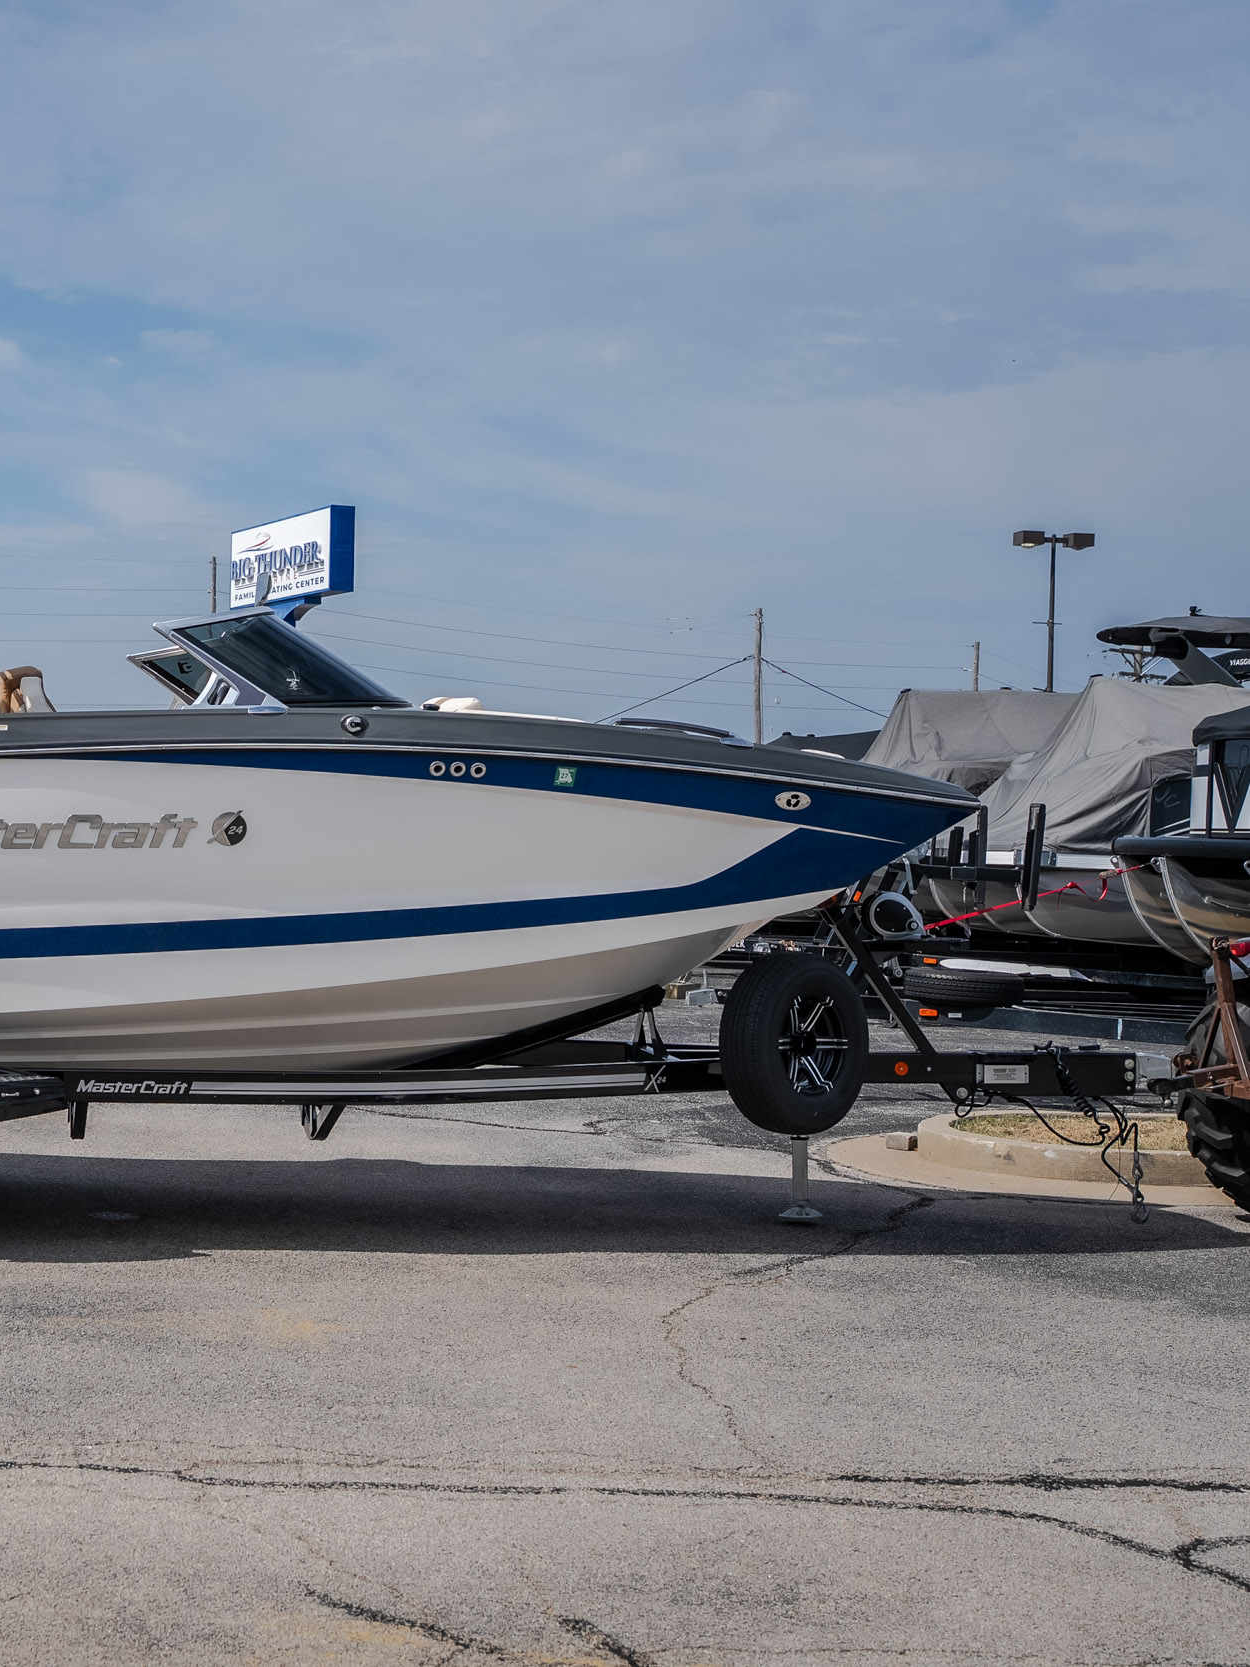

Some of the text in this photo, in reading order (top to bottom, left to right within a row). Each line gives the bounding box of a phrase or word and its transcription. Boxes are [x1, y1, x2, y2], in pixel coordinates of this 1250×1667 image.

[231, 541, 322, 580] BIG THUNDER
[234, 576, 325, 601] FAMIL ATING CENTER
[1229, 658, 1250, 666] VIAGGI
[227, 825, 244, 835] 24
[76, 1079, 188, 1094] MasterCraft
